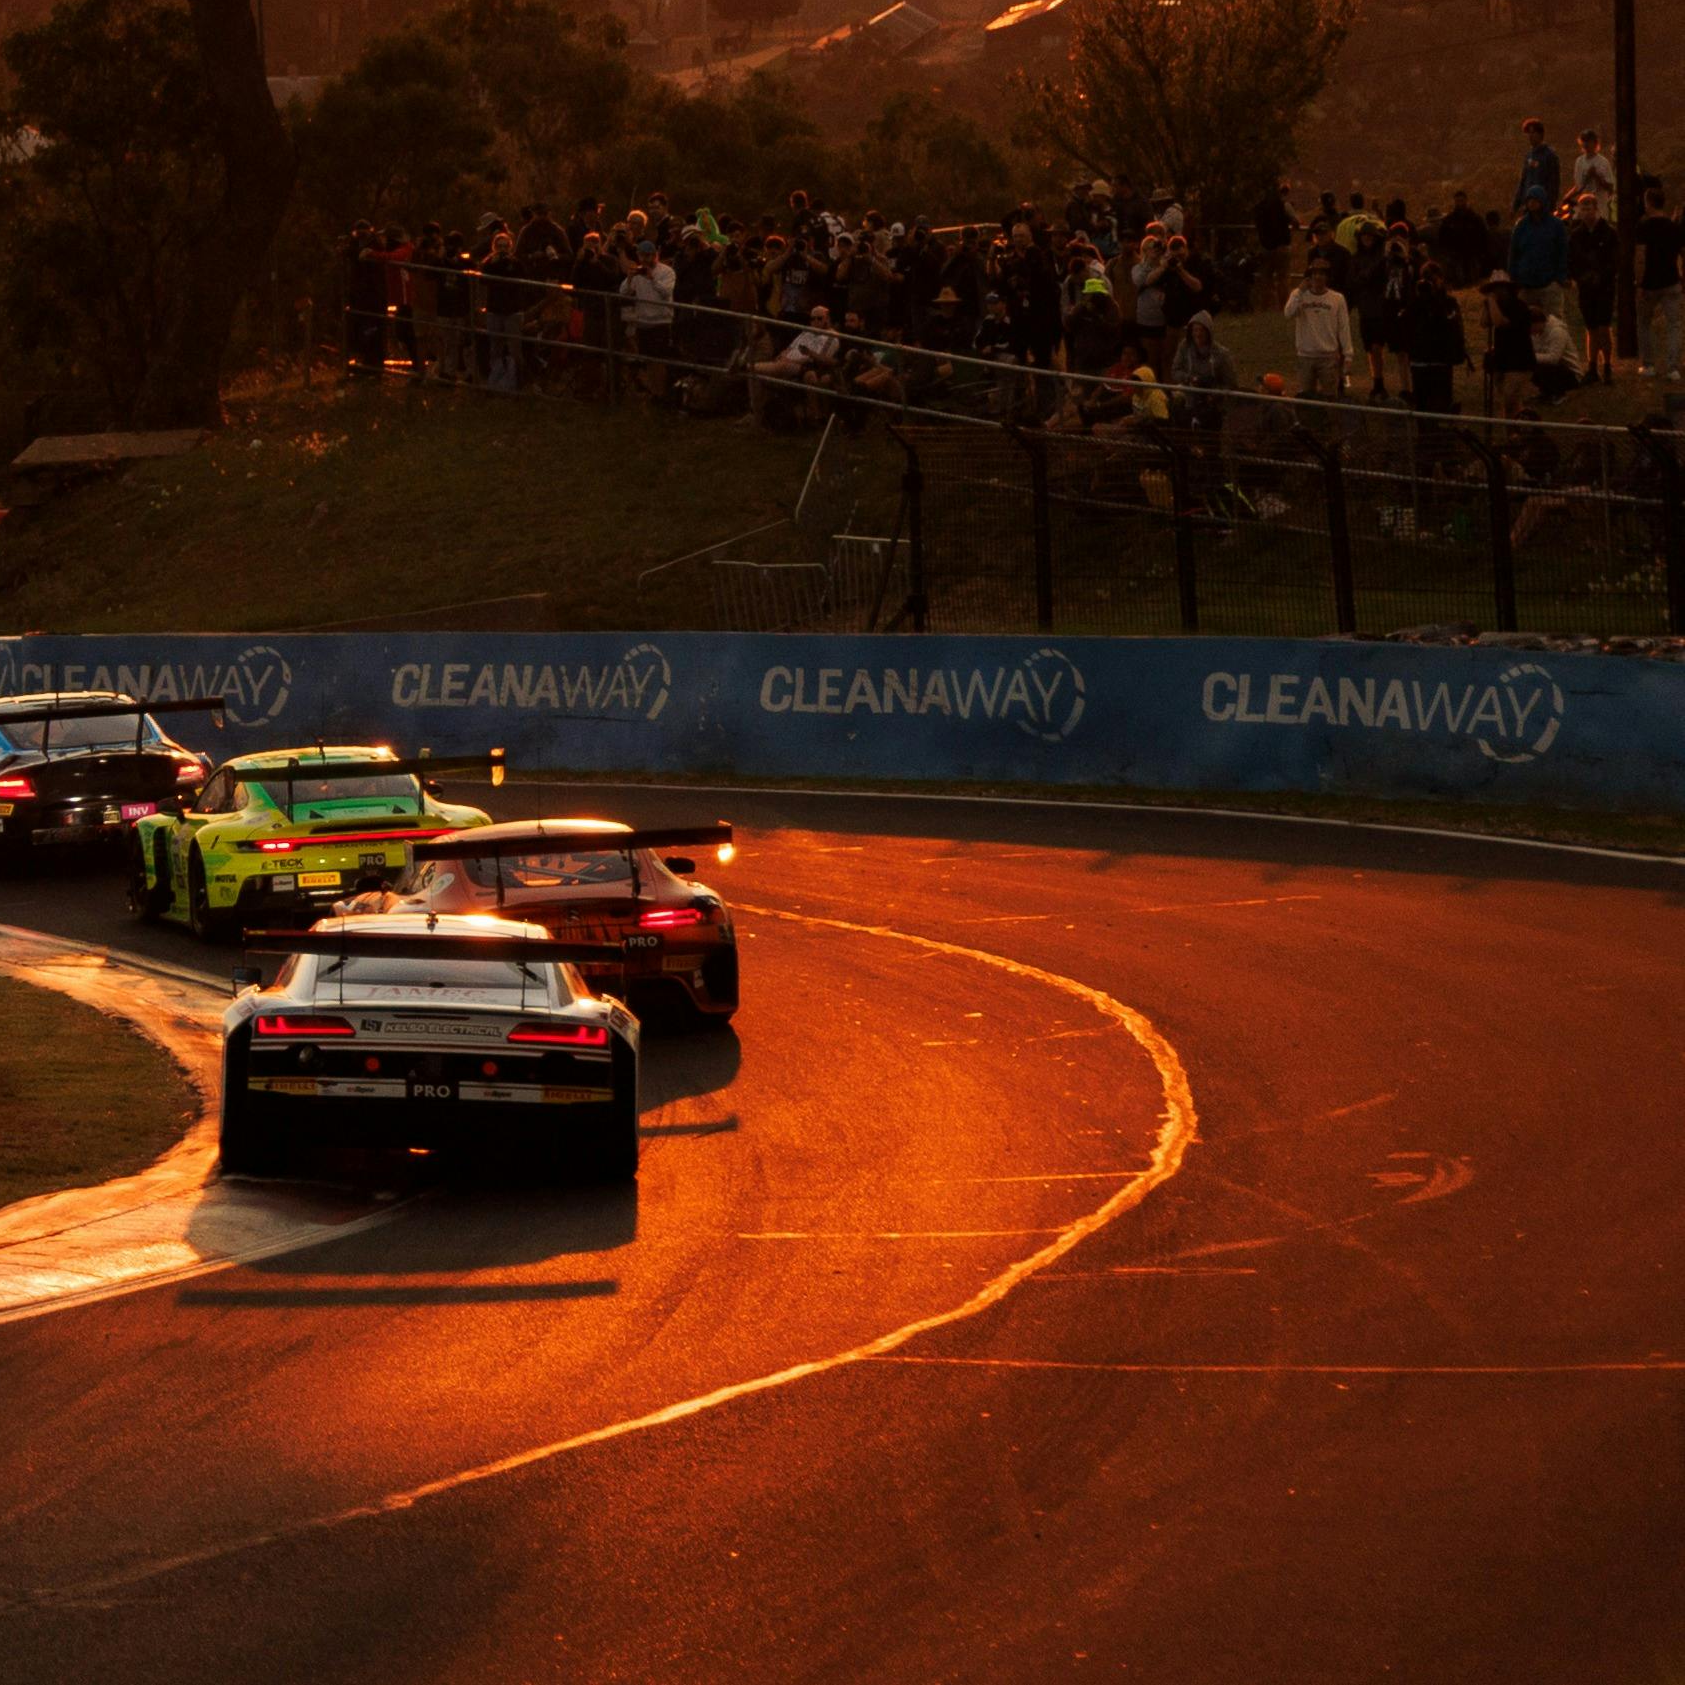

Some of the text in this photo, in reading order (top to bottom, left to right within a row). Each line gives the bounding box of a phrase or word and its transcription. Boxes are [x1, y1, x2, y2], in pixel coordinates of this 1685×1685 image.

[21, 665, 275, 705] CLEANAWAY
[391, 663, 656, 709] CLEANAWAY
[759, 665, 1063, 722] CLEANAWAY
[1202, 671, 1543, 737] CLEANAWAY
[128, 806, 149, 817] INV
[359, 854, 385, 867] PRO
[629, 936, 658, 948] PRO
[386, 1022, 426, 1033] KELSO
[428, 1023, 501, 1037] ELECTRICAL
[413, 1084, 451, 1098] PRO
